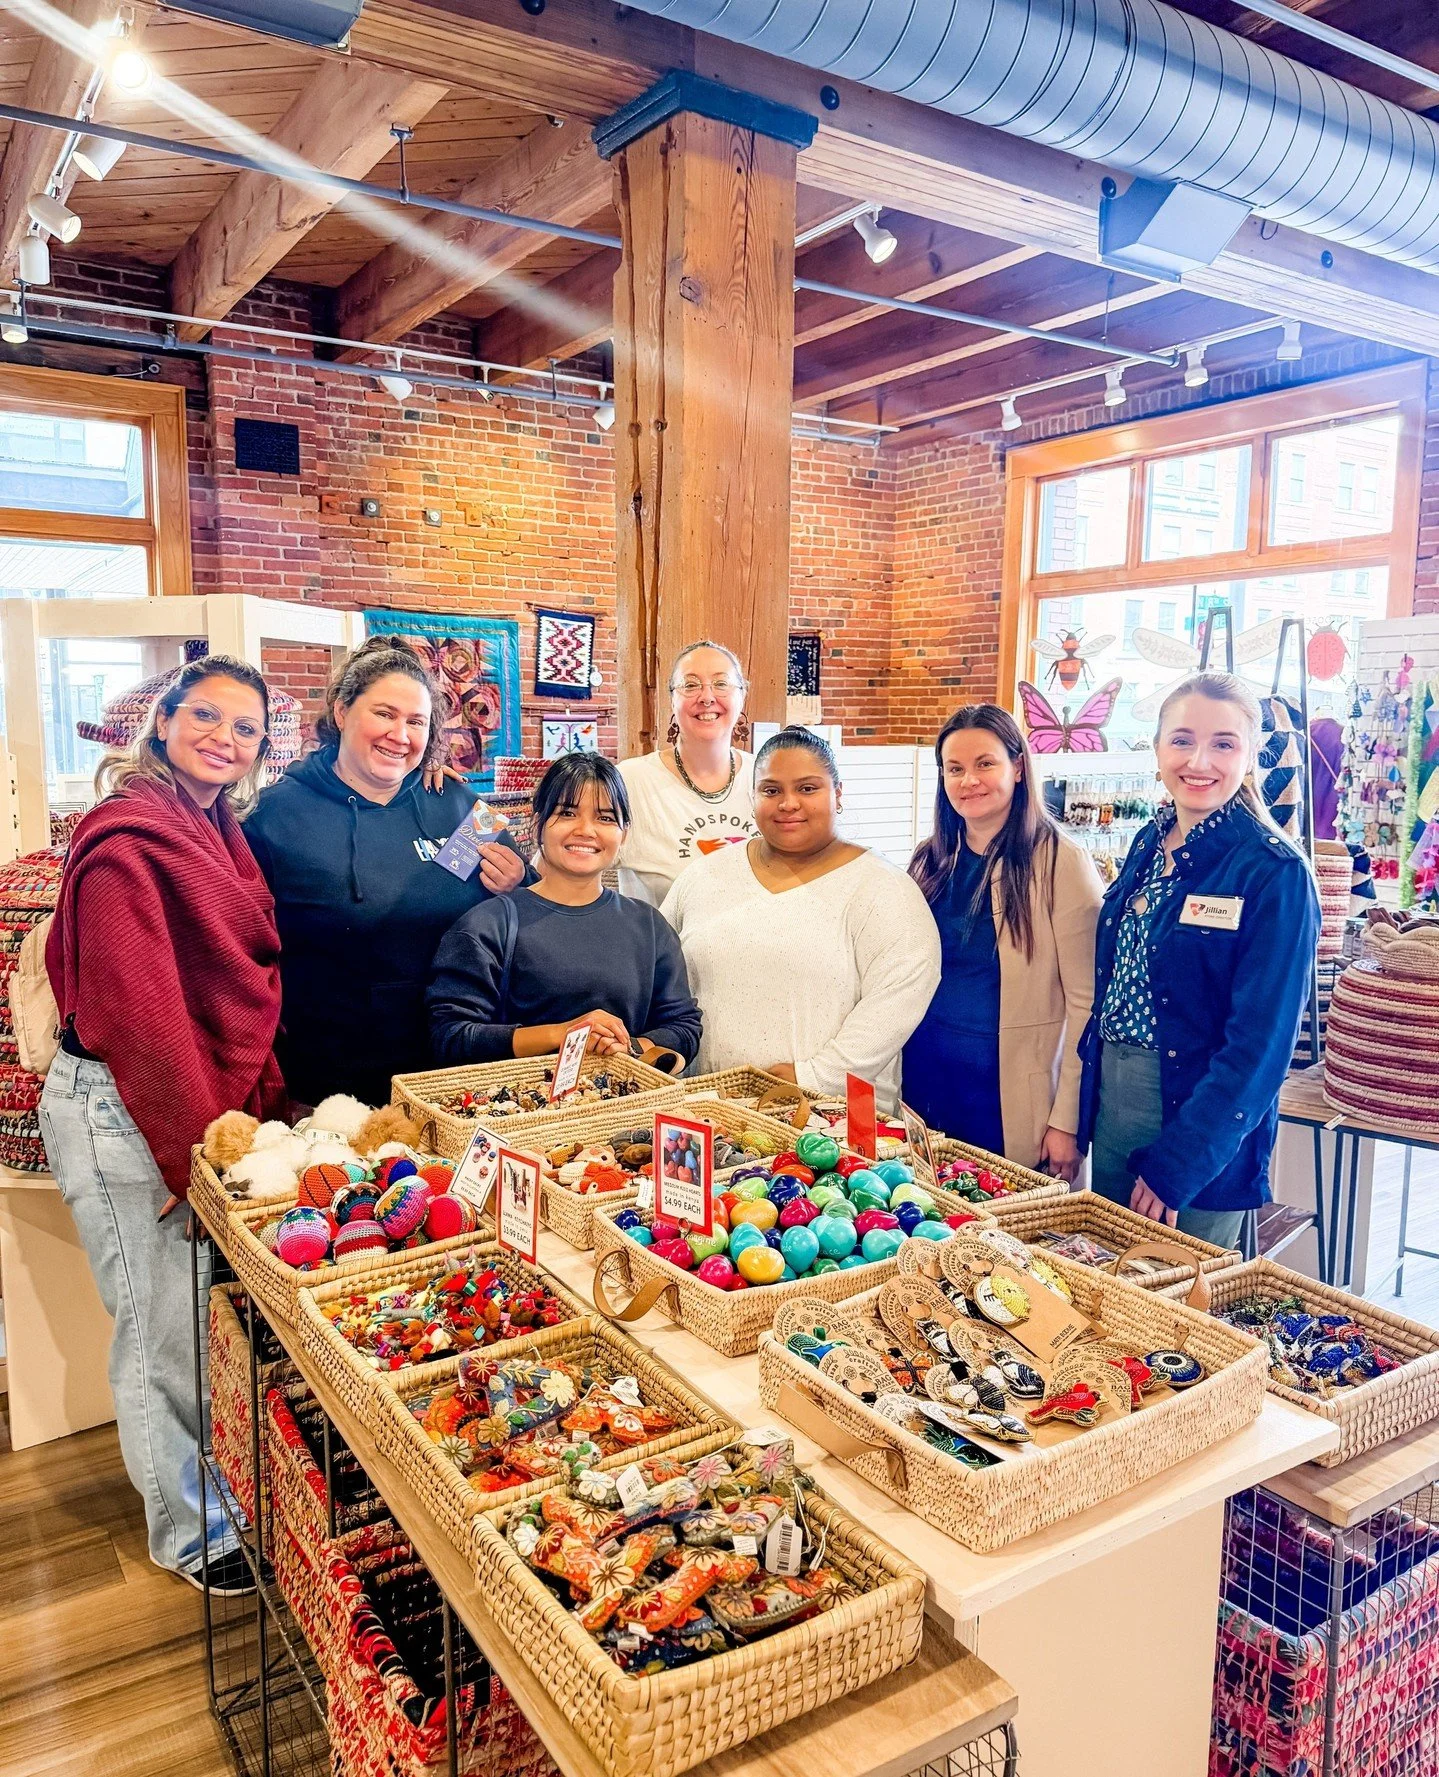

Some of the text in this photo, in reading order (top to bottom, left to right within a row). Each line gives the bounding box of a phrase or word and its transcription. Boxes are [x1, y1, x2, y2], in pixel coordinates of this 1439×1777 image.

[458, 824, 484, 846] Divi
[1204, 906, 1228, 915] Jillian
[664, 1196, 701, 1215] $4.99 EACH
[516, 1231, 531, 1246] EACH
[962, 1244, 990, 1253] crafted
[989, 1250, 1003, 1263] BAG
[904, 1285, 933, 1297] crafted
[930, 1296, 946, 1308] BAG
[784, 1305, 836, 1336] artisan crafted
[831, 1319, 849, 1330] BAG
[890, 1319, 907, 1332] KEY
[848, 1357, 879, 1373] crafted
[875, 1374, 892, 1386] BAG
[1098, 1368, 1124, 1383] crafted
